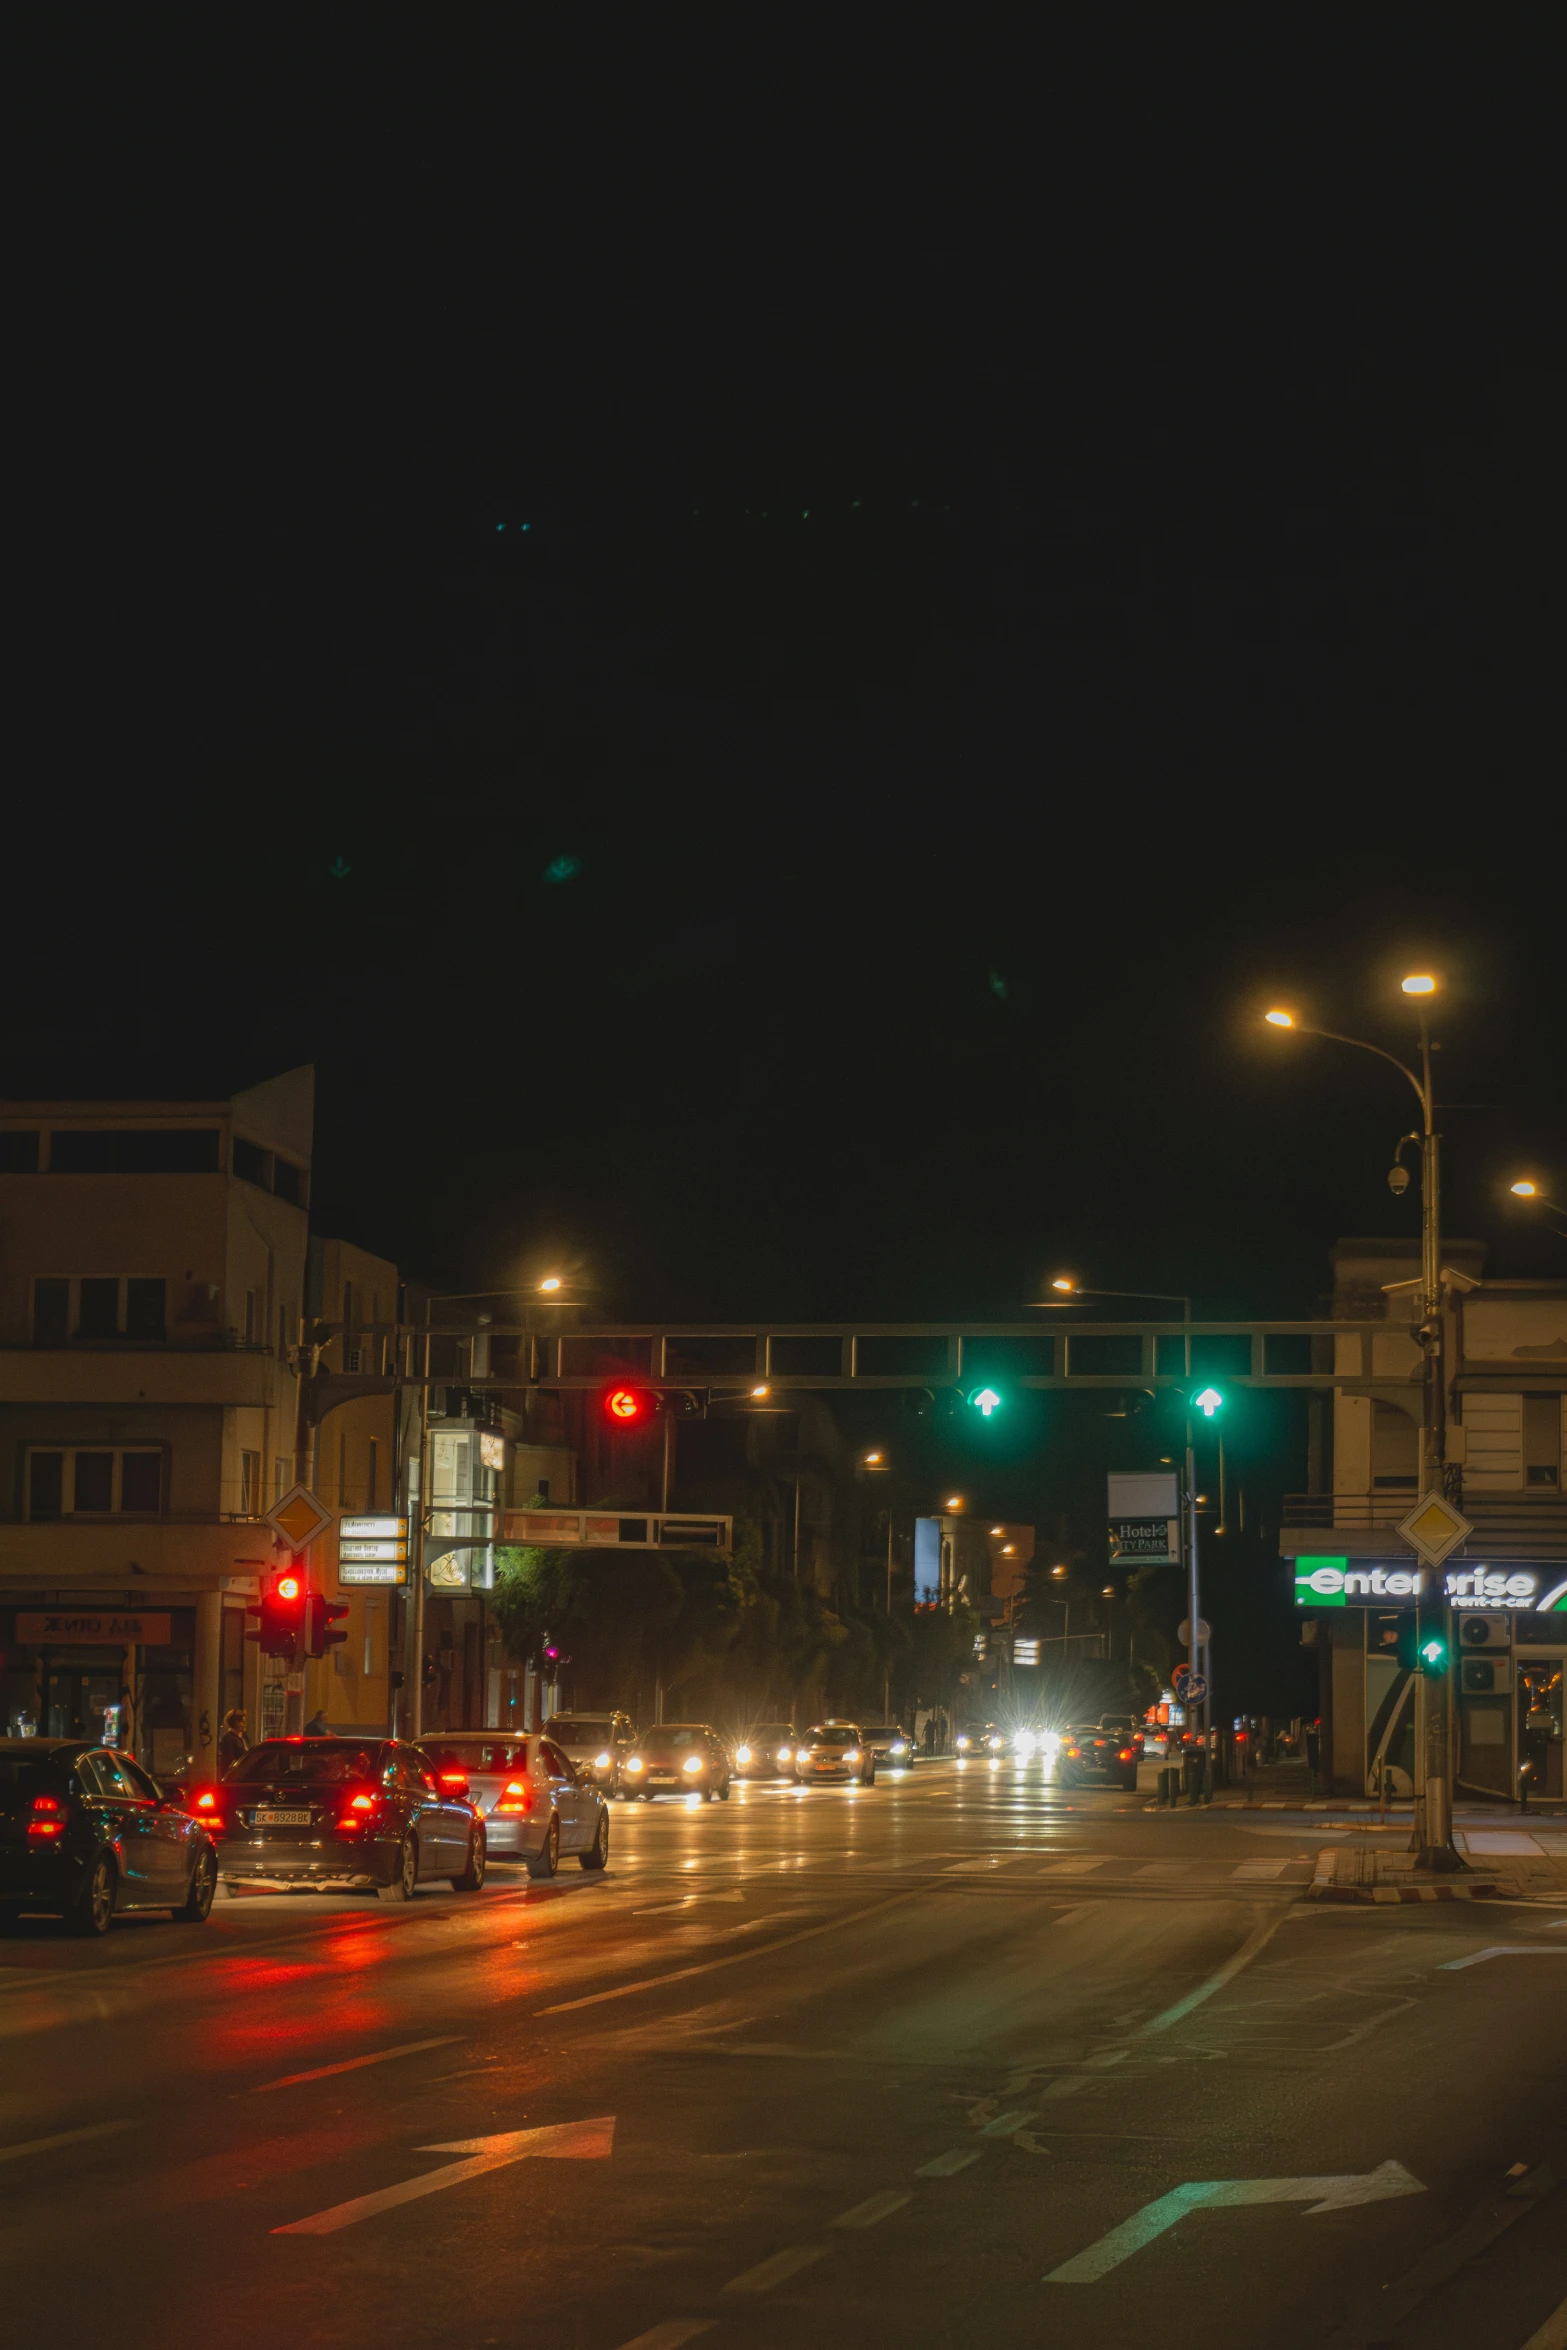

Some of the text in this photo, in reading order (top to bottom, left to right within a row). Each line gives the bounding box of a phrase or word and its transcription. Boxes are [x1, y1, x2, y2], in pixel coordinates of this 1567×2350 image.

[1119, 1524, 1156, 1538] Hotel
[1138, 1539, 1167, 1550] PARK
[1450, 1596, 1534, 1608] rent-a-car
[256, 1813, 267, 1823] SK
[274, 1813, 297, 1823] 8928
